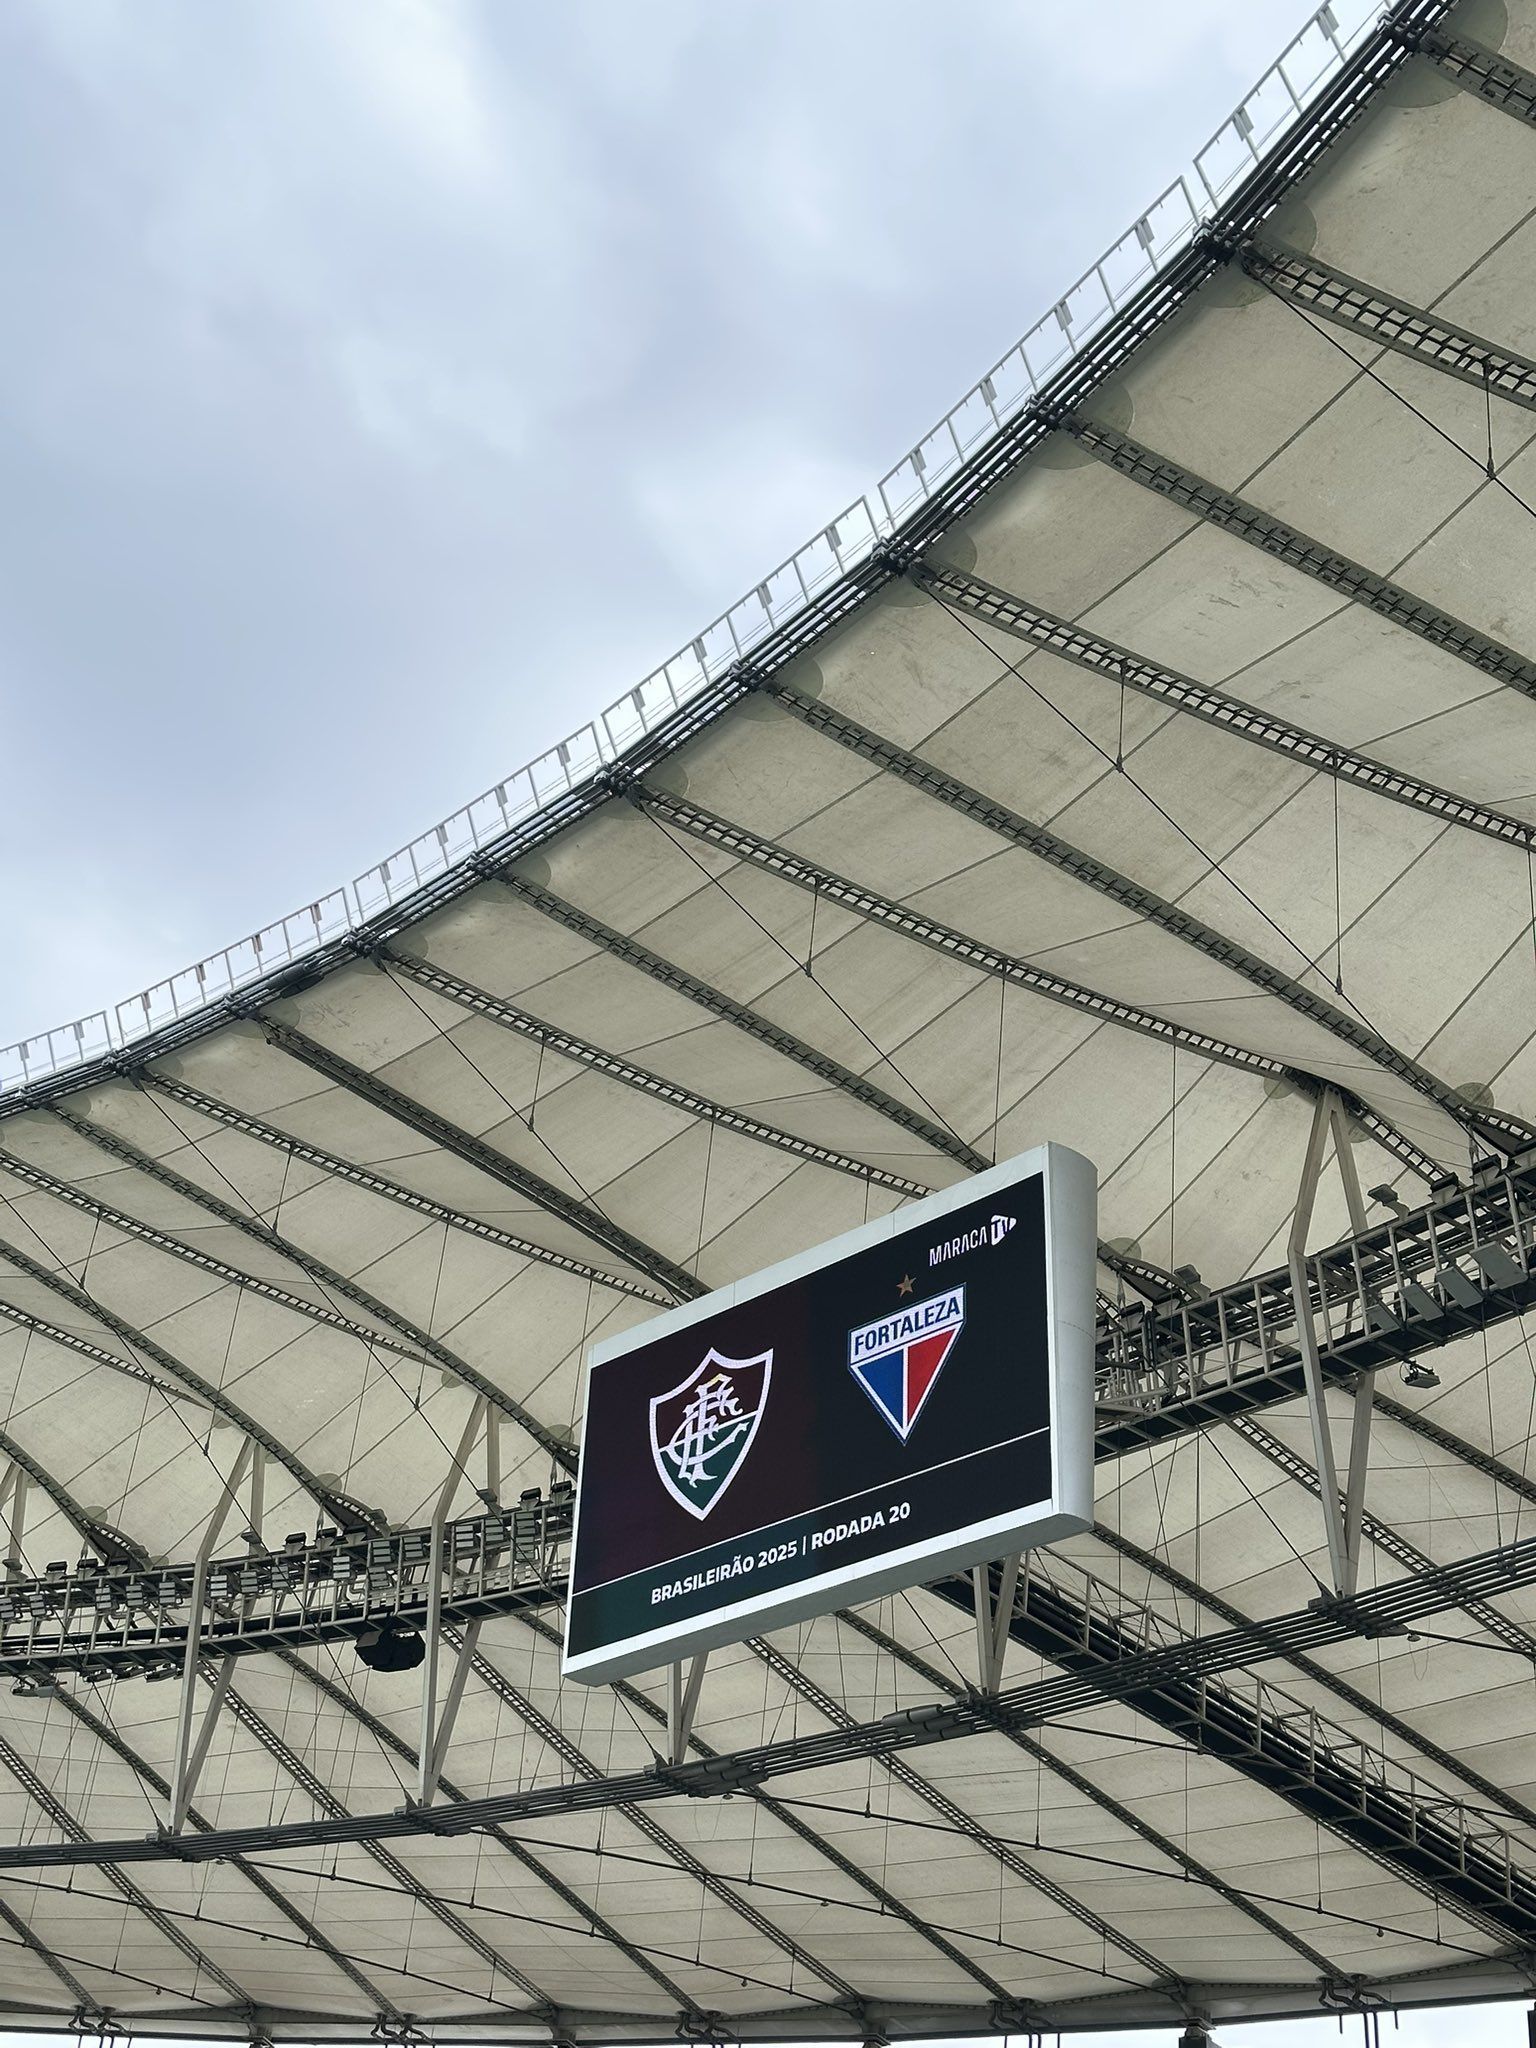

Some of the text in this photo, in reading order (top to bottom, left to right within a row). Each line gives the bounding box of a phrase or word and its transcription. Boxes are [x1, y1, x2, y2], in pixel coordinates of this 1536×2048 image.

[929, 1226, 988, 1267] MARACA
[854, 1296, 961, 1356] FORTALEZA
[651, 1501, 911, 1605] BRASILEIRÃO 2025 RODADA 20
